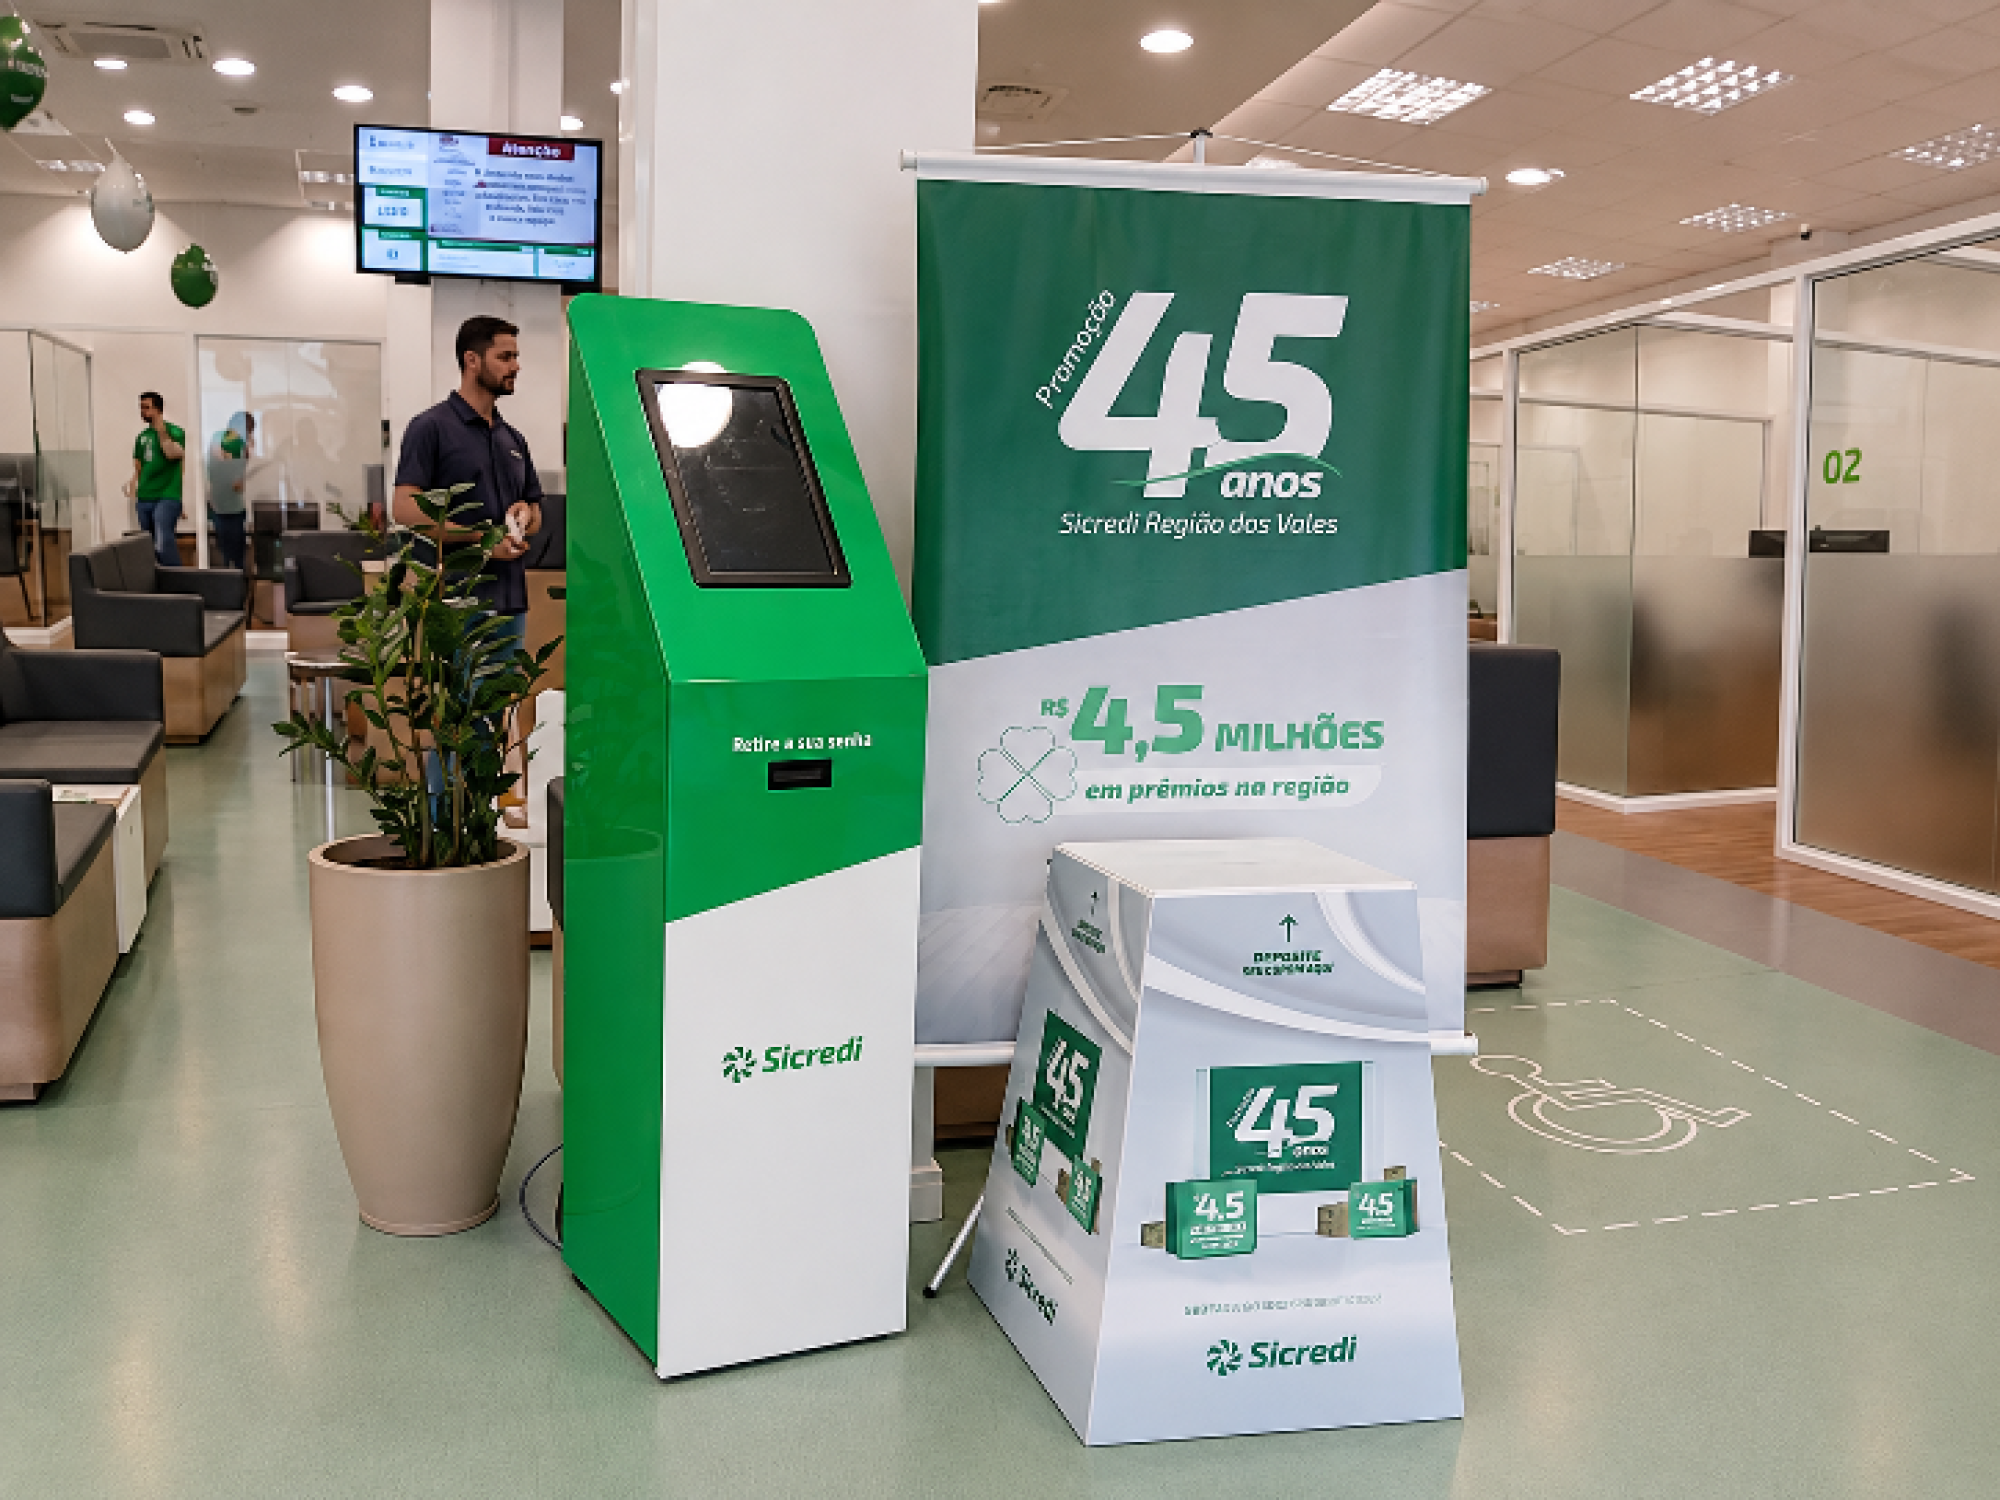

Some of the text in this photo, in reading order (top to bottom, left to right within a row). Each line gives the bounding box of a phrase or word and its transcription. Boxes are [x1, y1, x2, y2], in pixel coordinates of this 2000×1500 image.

[1036, 289, 1116, 410] Promoção
[1057, 292, 1349, 499] 45
[1823, 447, 1863, 484] 02
[1220, 470, 1323, 499] anos
[1058, 511, 1339, 540] Sicredi Região das Vales
[732, 731, 873, 753] Retire a sua senha
[1041, 685, 1385, 763] R$ 4,5 MILHÕES
[1086, 774, 1351, 804] em prêmios na região
[761, 1034, 863, 1073] Sicredi
[1234, 1083, 1341, 1158] 45
[1249, 1334, 1357, 1369] Sicredi
